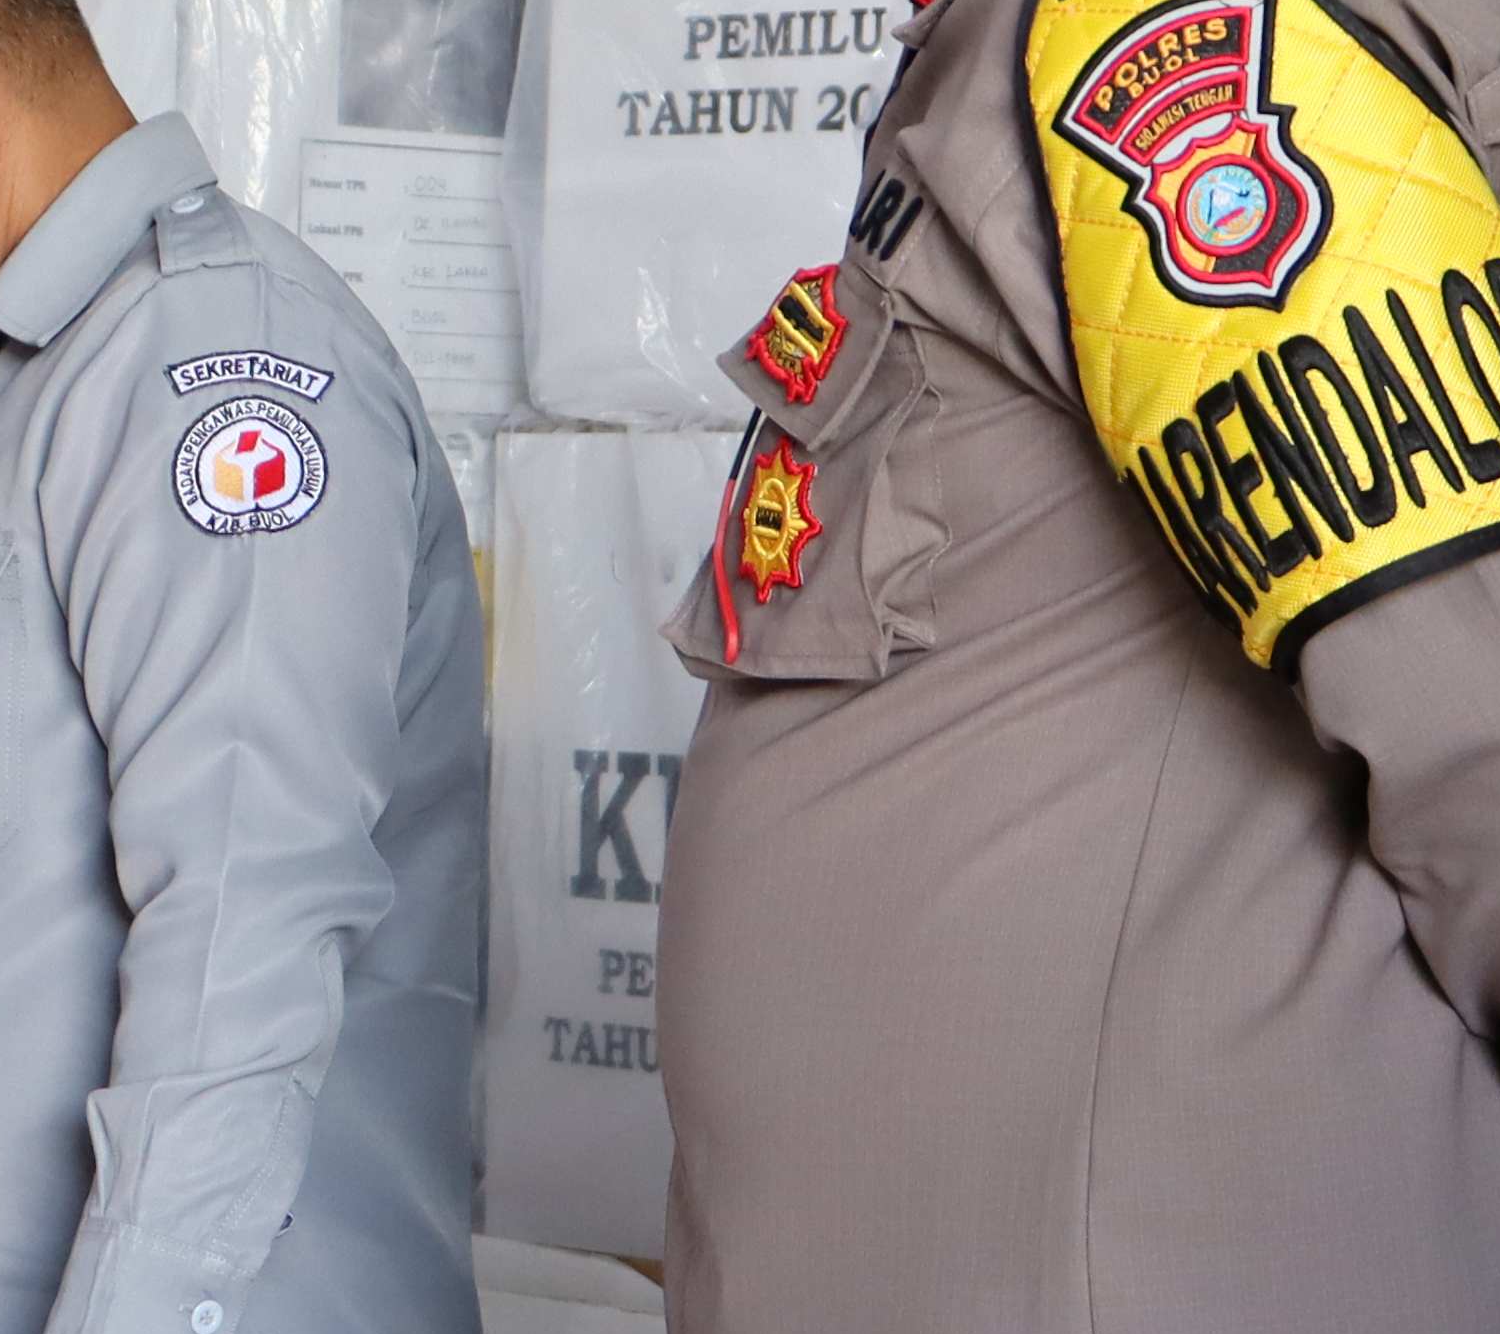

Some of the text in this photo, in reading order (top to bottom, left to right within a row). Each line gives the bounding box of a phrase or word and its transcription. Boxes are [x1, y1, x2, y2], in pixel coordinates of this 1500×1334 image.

[682, 6, 889, 62] PEMILU
[1094, 17, 1229, 113] POLRES
[616, 83, 874, 139] TAHUN 20
[179, 355, 320, 393] SEKRETARIAT
[182, 401, 256, 458] PENGAWAS
[542, 1016, 660, 1073] TAHU
